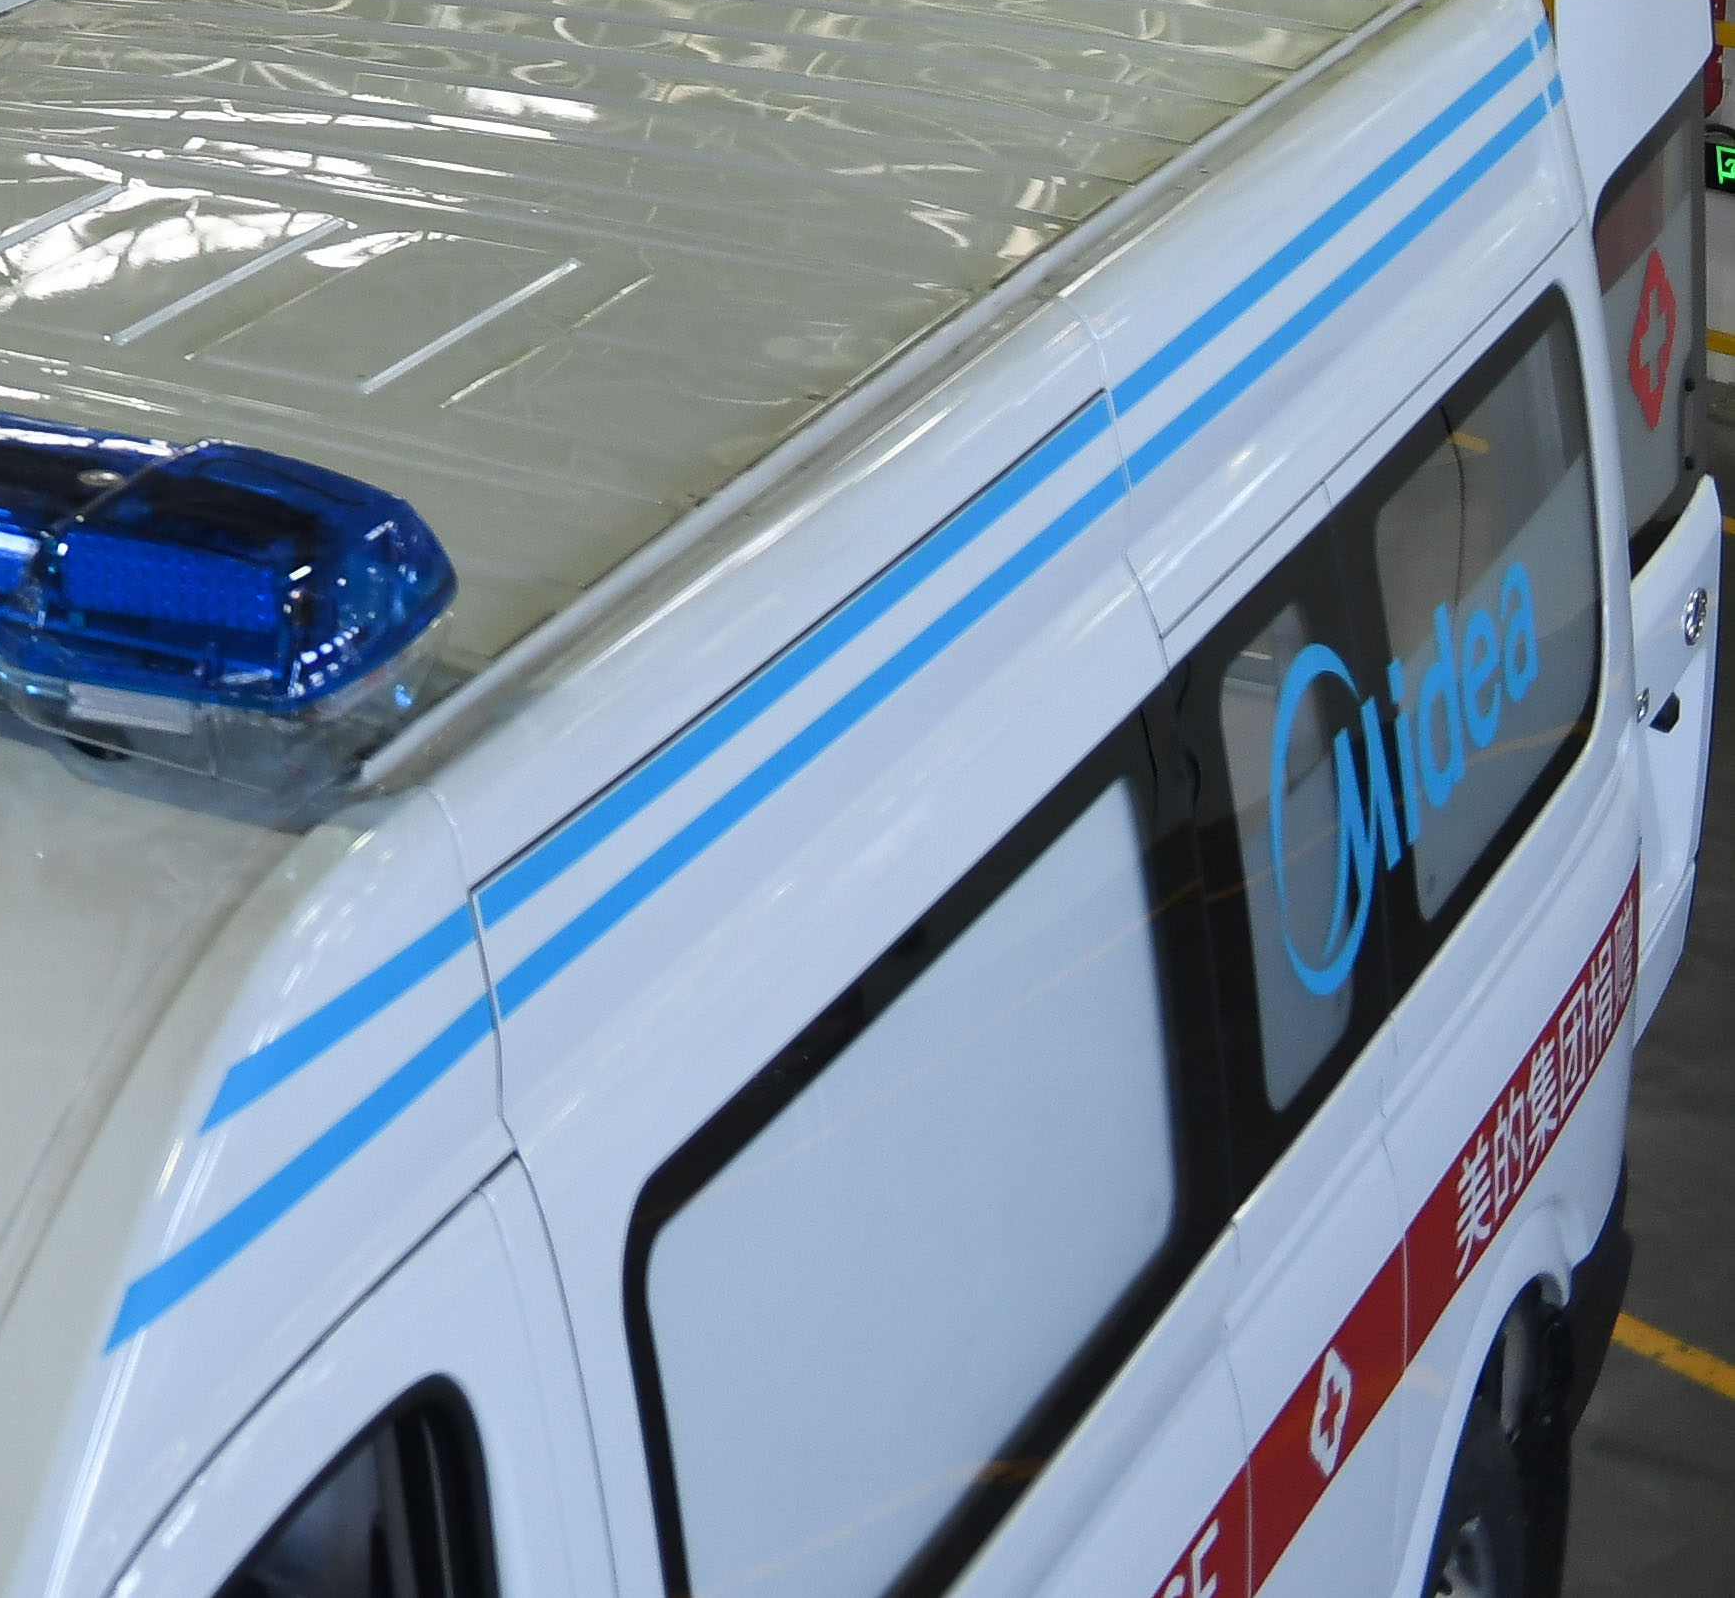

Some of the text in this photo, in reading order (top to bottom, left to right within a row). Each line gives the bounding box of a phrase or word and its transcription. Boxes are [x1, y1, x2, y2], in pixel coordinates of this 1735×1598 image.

[1270, 560, 1540, 997] Midea
[1454, 890, 1638, 1278] 美的集团捐赠
